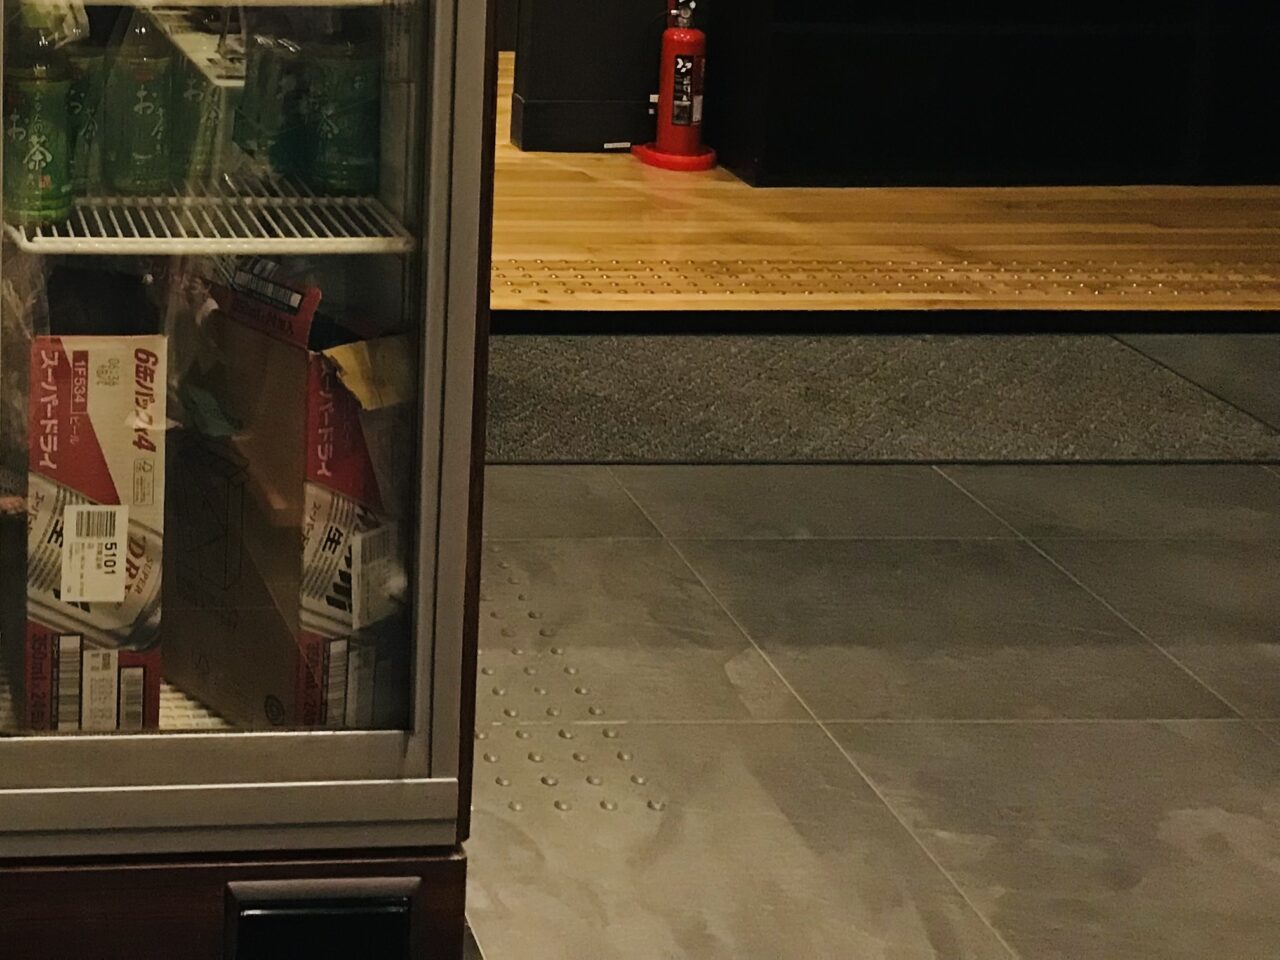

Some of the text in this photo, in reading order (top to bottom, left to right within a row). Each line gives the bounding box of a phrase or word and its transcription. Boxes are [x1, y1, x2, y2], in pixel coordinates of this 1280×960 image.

[74, 360, 86, 403] 1F534
[40, 350, 59, 470] スーパードライ
[103, 542, 118, 575] 5101
[135, 556, 154, 595] SUPER
